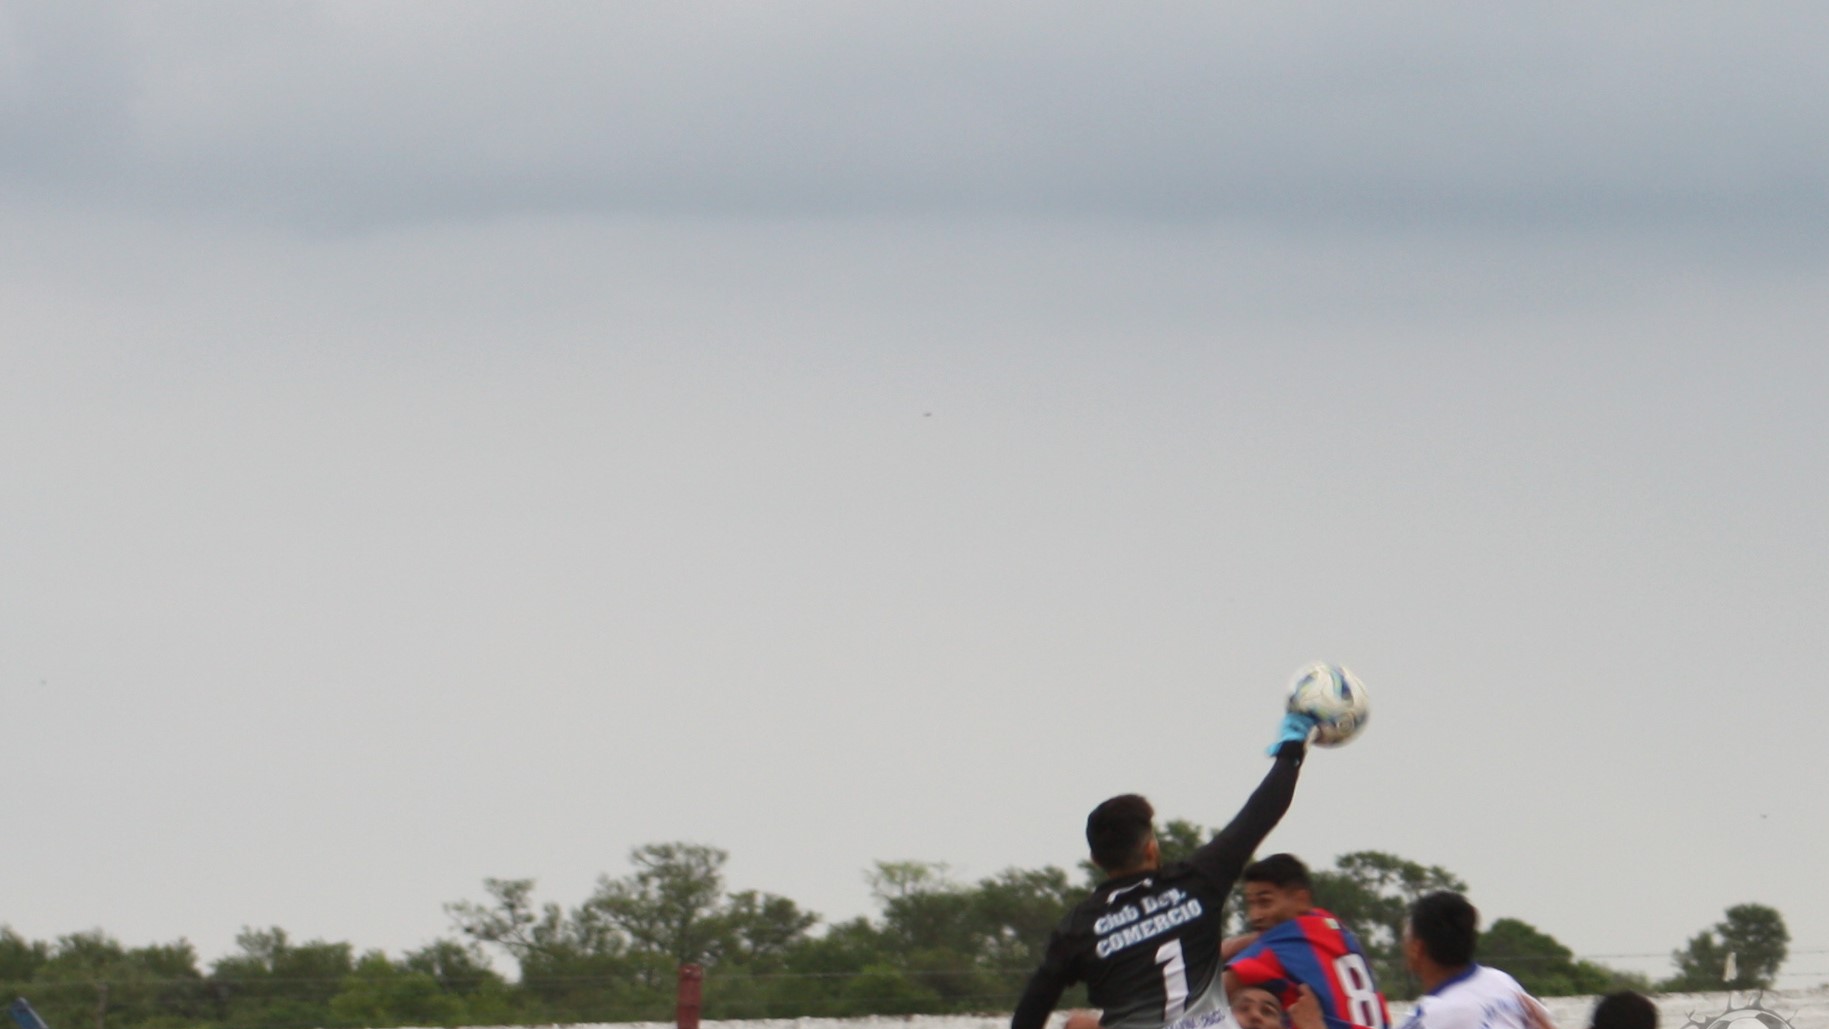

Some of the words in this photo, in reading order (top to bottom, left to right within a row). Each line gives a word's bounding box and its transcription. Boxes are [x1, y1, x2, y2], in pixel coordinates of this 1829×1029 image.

[1093, 903, 1140, 935] Club
[1095, 898, 1203, 958] COMERCIO
[1155, 938, 1189, 1022] 1
